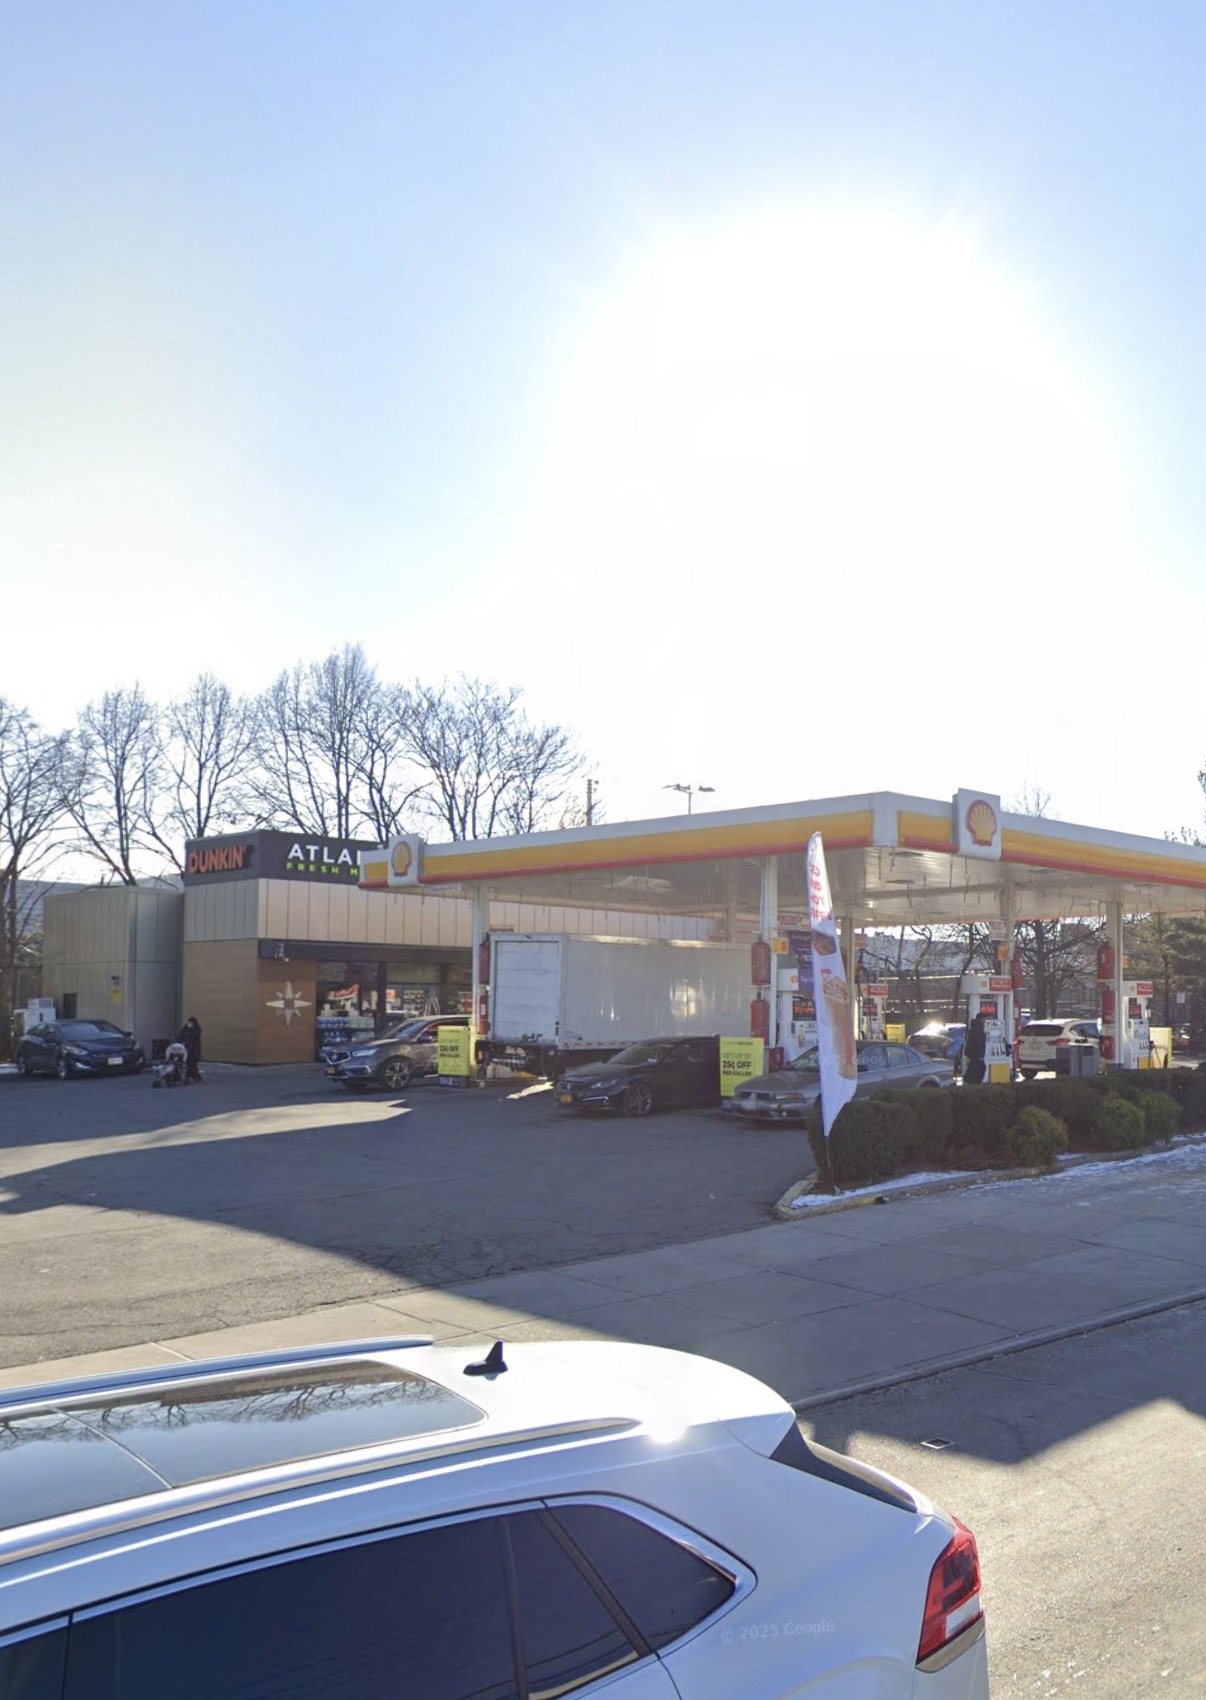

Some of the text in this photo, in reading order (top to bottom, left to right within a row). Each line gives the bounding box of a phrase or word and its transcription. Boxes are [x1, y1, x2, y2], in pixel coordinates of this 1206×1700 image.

[286, 861, 339, 874] FRESH
[722, 1060, 752, 1070] 25¢ OFF
